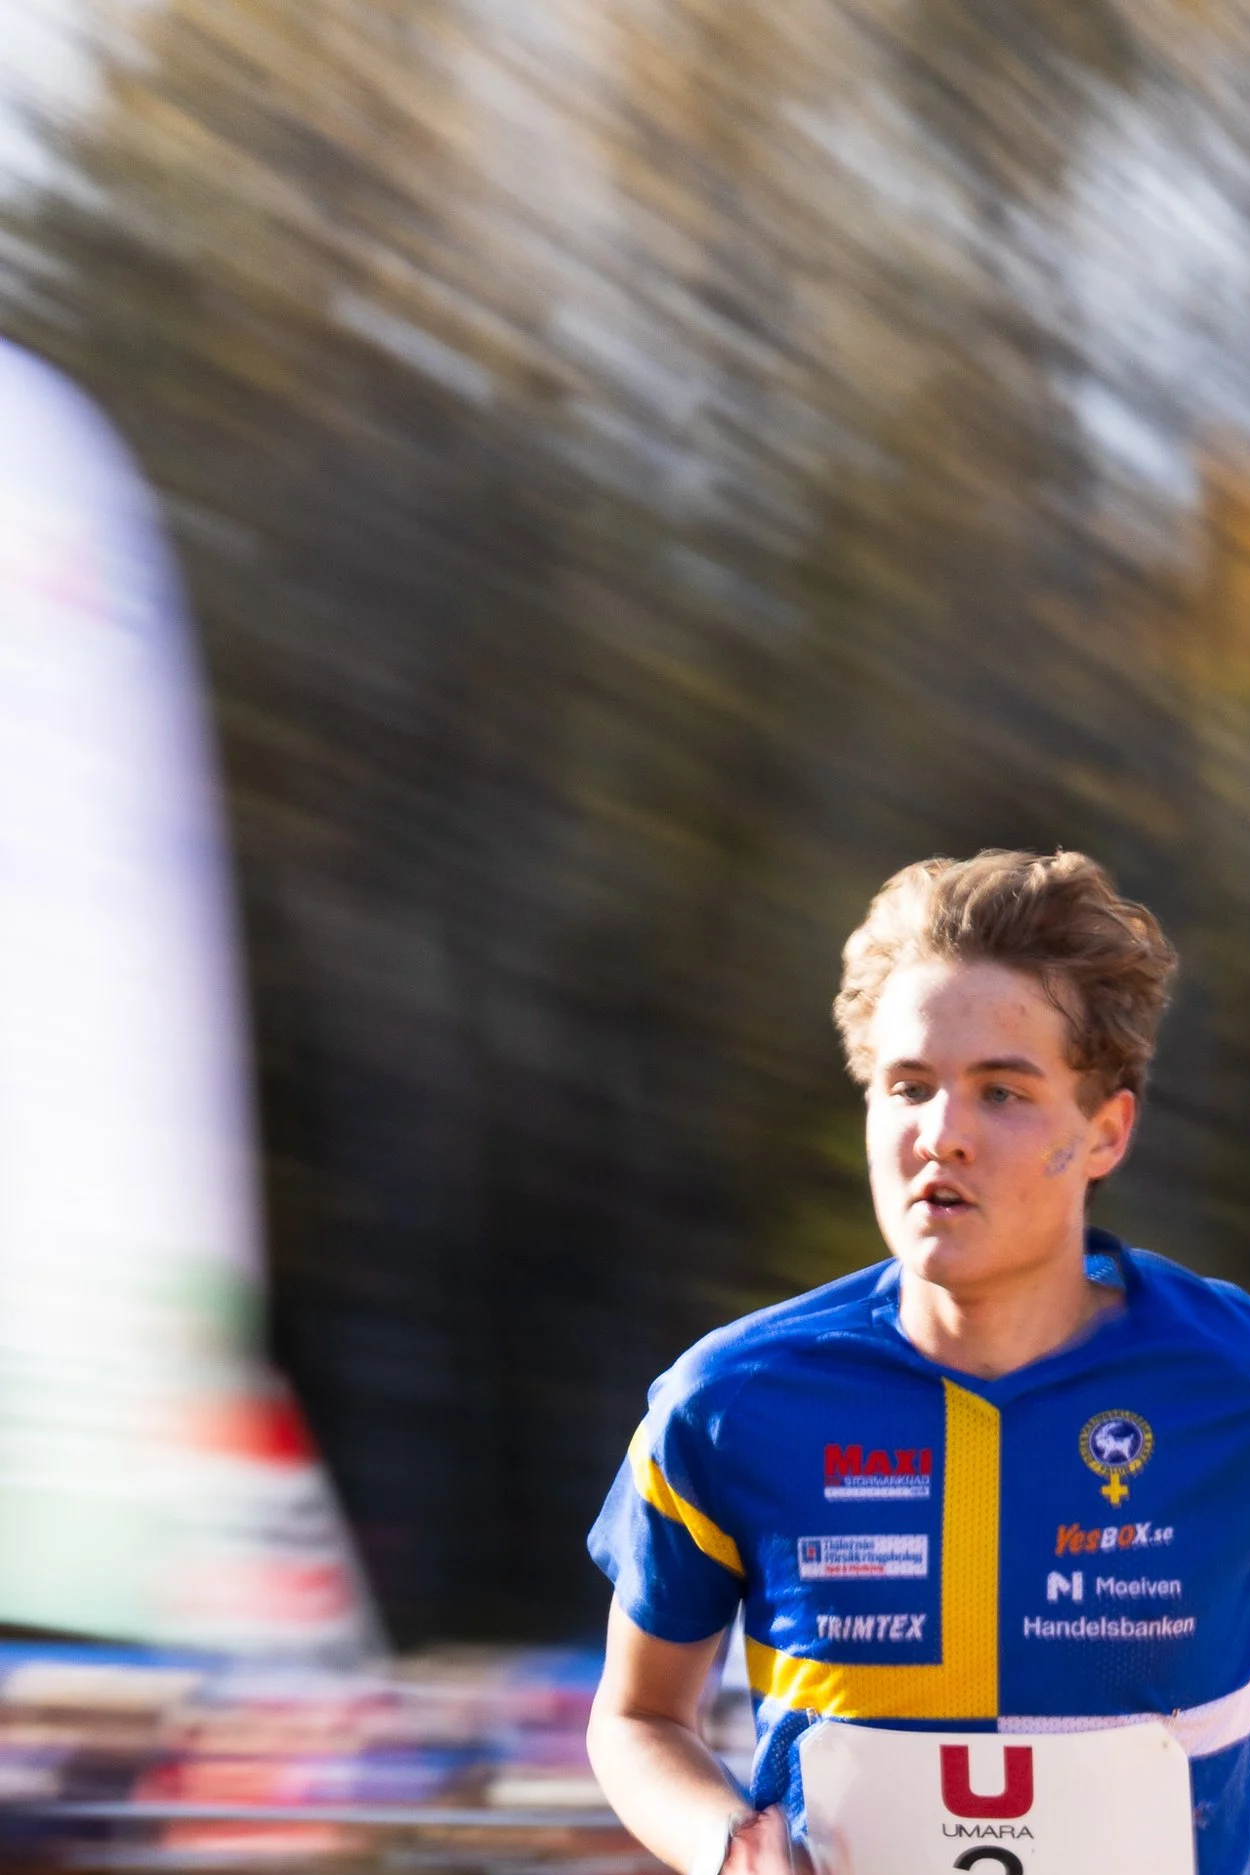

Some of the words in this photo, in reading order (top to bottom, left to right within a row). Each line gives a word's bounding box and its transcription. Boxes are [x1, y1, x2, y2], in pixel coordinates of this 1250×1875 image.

[1096, 1576, 1182, 1599] Moelven
[816, 1613, 927, 1643] TRIMTEX
[1023, 1614, 1196, 1639] Handelsbanken
[942, 1823, 1034, 1840] UMARA
